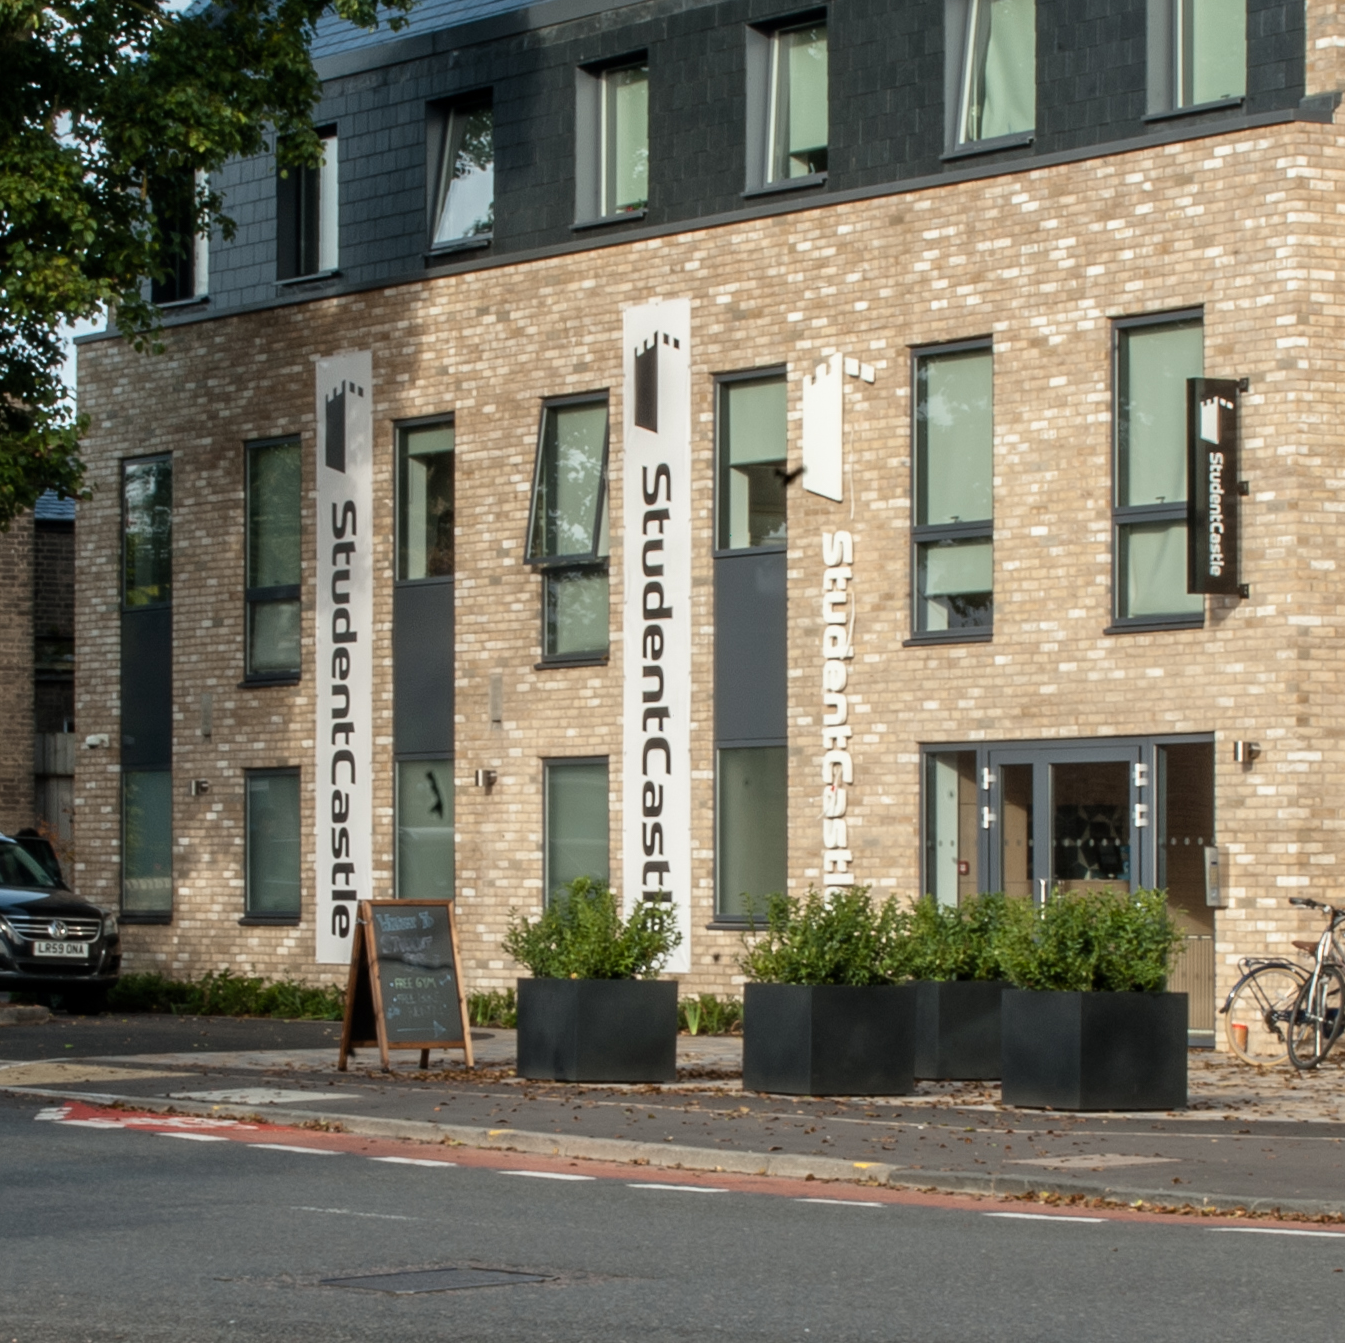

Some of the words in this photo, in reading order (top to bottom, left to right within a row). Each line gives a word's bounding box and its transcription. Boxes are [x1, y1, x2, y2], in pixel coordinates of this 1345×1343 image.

[1209, 452, 1225, 576] StudentCastle
[331, 500, 358, 939] StudentCastle
[38, 943, 64, 954] LR59
